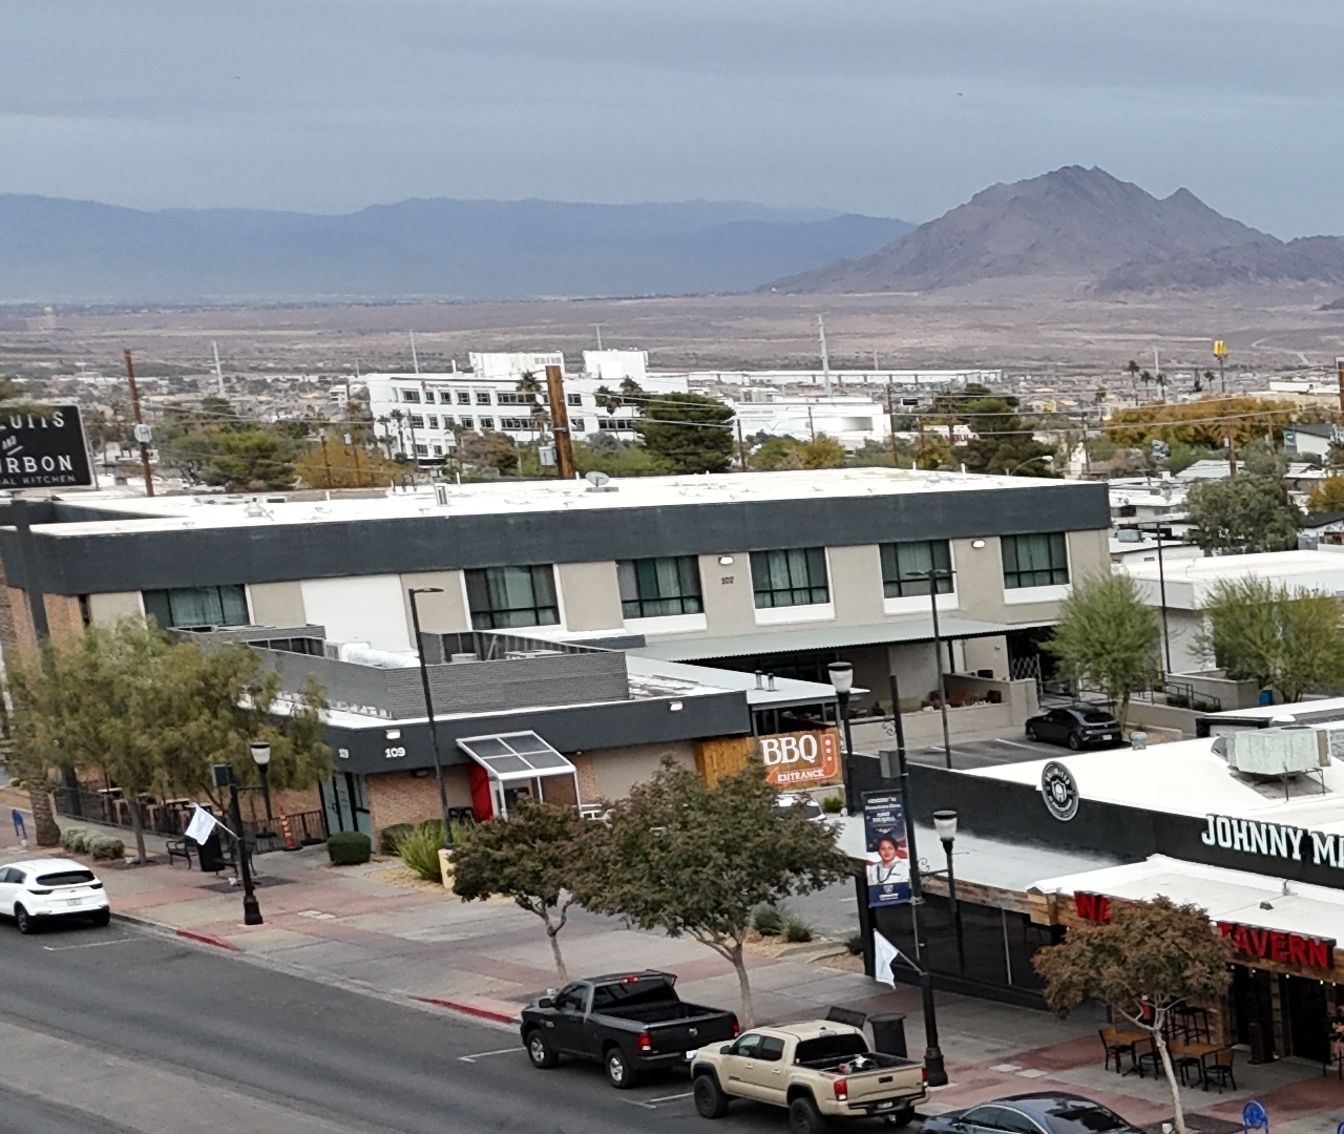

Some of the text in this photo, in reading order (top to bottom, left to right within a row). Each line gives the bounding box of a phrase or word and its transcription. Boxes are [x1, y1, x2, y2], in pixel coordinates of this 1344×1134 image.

[0, 411, 65, 429] UIS
[0, 455, 73, 473] RBON
[384, 747, 406, 758] 109
[761, 734, 818, 765] BBQ
[777, 768, 825, 784] ENTRANCE
[1201, 814, 1304, 861] JOHNNY
[1217, 920, 1330, 970] TAVERN
